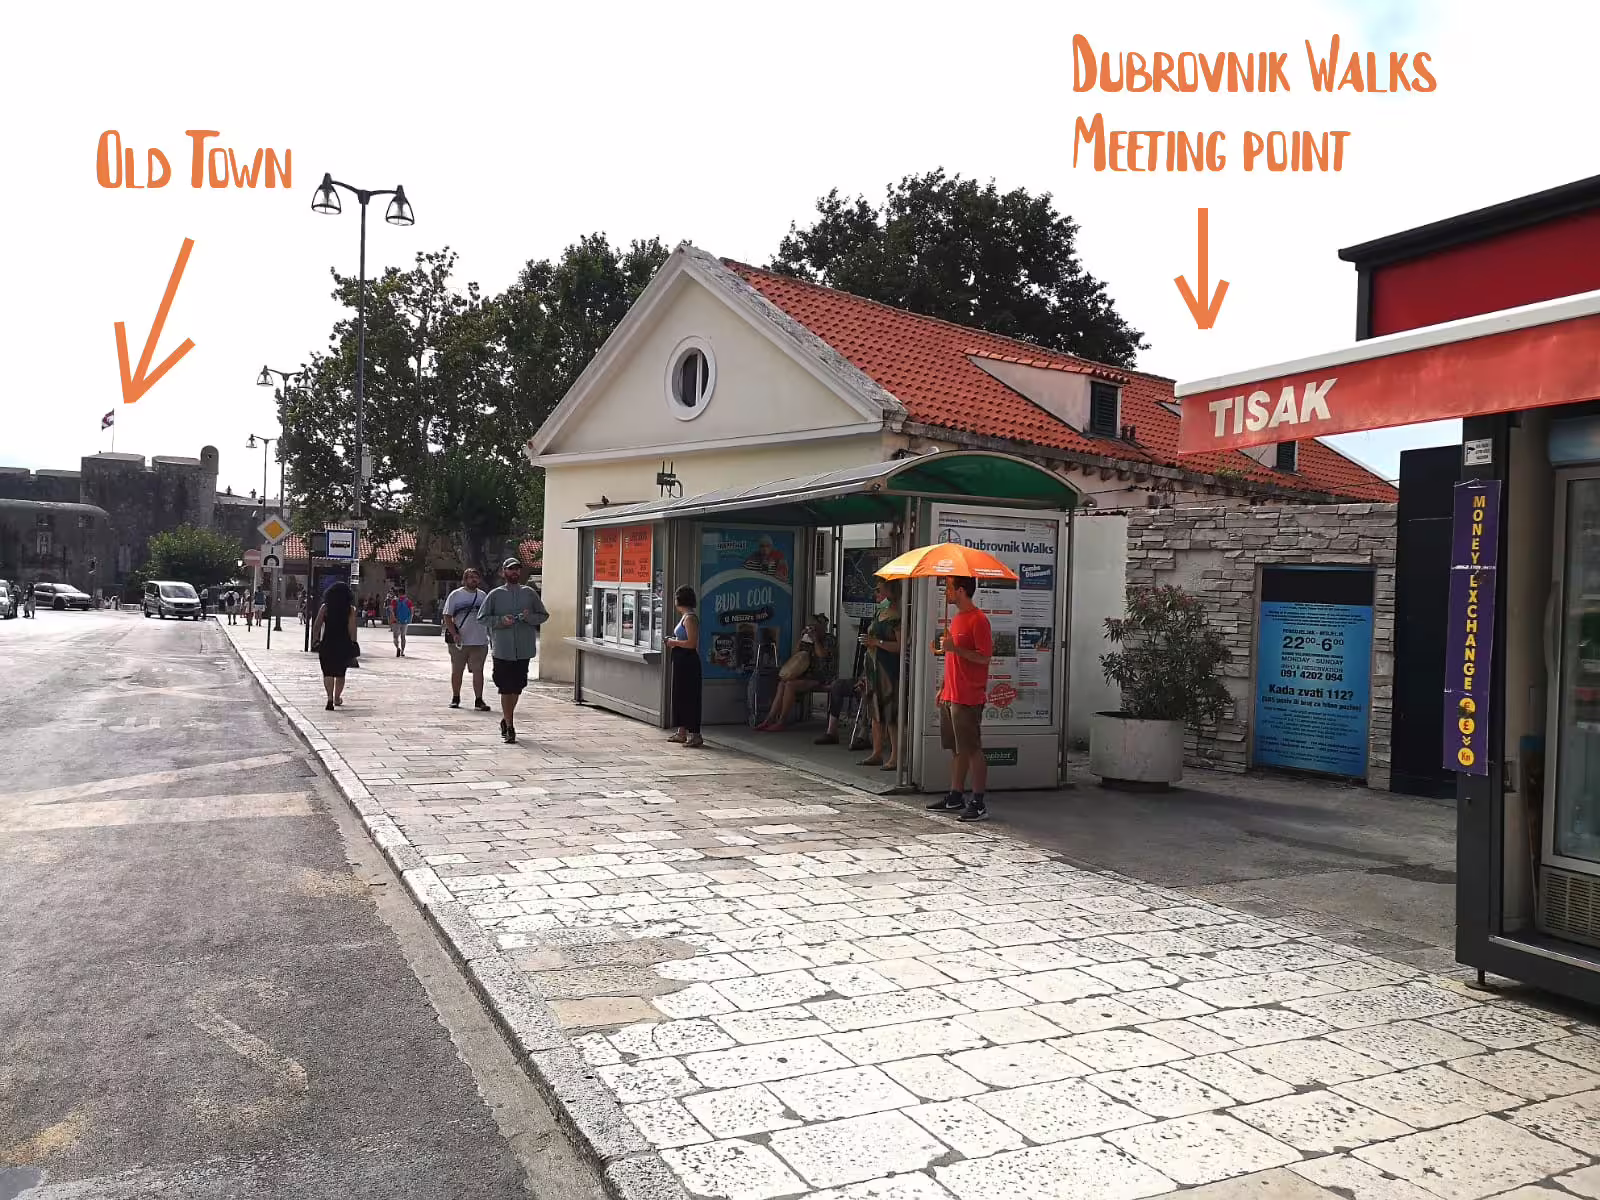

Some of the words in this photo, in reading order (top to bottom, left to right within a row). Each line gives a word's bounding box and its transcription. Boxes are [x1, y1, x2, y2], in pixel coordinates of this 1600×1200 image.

[1208, 378, 1338, 437] TISAK
[1470, 495, 1486, 565] MONEY
[964, 539, 1020, 553] Dubrovnik
[1021, 541, 1054, 555] Walks
[715, 592, 740, 613] BUDI
[747, 586, 775, 607] COOL
[1463, 574, 1479, 690] EXCHANGE
[1281, 656, 1311, 664] MONDAY
[1316, 658, 1344, 666] SUNDAY
[1281, 669, 1297, 678] 091
[1300, 671, 1323, 680] 4202
[1325, 673, 1343, 682] 094
[1269, 684, 1295, 696] Kada
[1298, 688, 1323, 698] zvati
[1327, 689, 1354, 701] 112?
